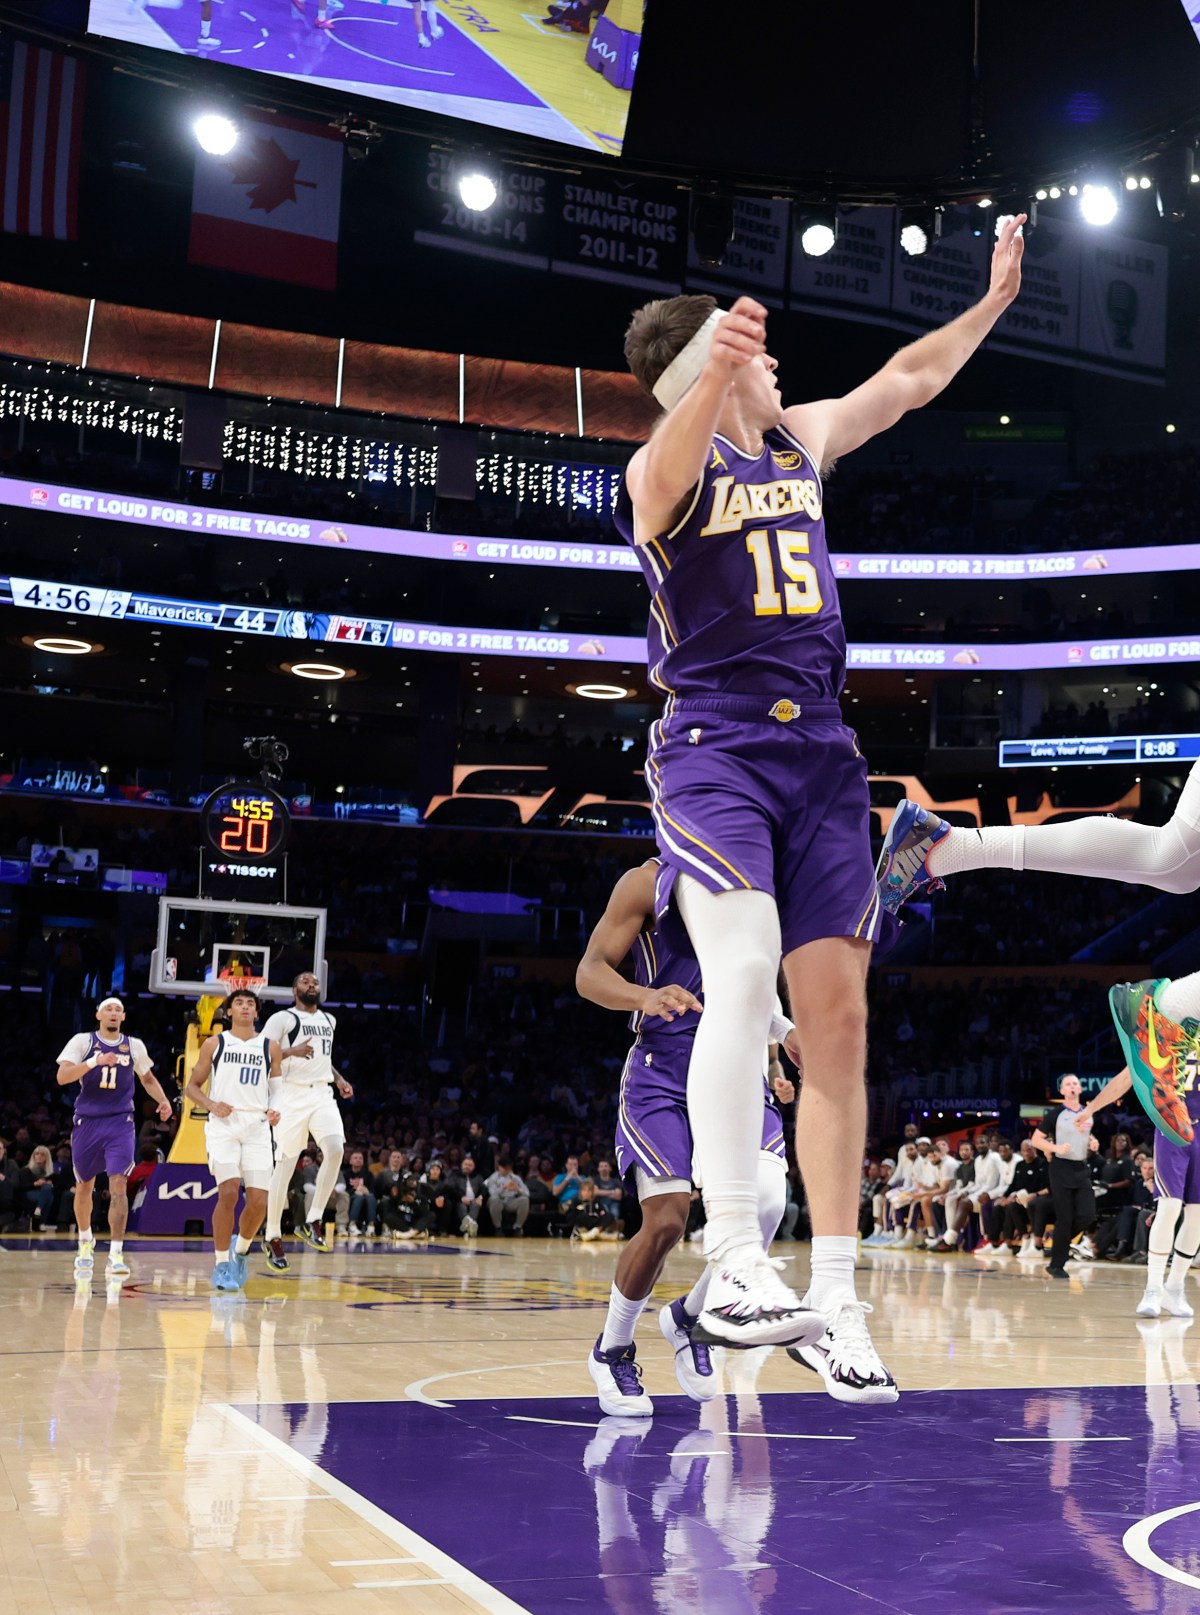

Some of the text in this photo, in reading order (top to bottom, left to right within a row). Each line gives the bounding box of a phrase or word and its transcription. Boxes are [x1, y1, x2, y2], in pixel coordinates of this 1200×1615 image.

[510, 173, 546, 193] CUP
[564, 184, 678, 222] STANLEY CUP
[562, 204, 677, 244] CHAMPIONS
[578, 233, 659, 271] 2011-12
[814, 271, 869, 293] 2011-12
[904, 269, 977, 297] CHAMPIONS
[1006, 311, 1060, 336] 1990-91
[58, 492, 95, 511] GET
[97, 498, 148, 519] LOUD
[151, 506, 188, 525] FOR
[191, 511, 203, 526] 2
[205, 513, 251, 532] FREE
[255, 519, 311, 538] TACOS
[700, 475, 823, 537] LAKERS
[477, 542, 509, 557] GET
[511, 544, 557, 561] LOUD
[560, 548, 593, 563] FOR
[596, 551, 607, 563] 2
[610, 550, 641, 566] FRE
[745, 529, 823, 616] 15
[858, 558, 891, 573] GET
[891, 559, 935, 574] LOUD
[937, 559, 970, 574] FOR
[972, 560, 982, 574] 2
[985, 559, 1025, 574] FREE
[1027, 557, 1075, 573] TACOS
[24, 584, 91, 611] 4:56
[111, 601, 122, 617] 2
[134, 601, 214, 623] Mavericks
[234, 610, 266, 632] 44
[345, 628, 357, 641] 4
[371, 630, 382, 643] 6
[418, 631, 453, 646] FOR
[457, 633, 467, 647] 2
[470, 635, 513, 650] FREE
[516, 637, 569, 653] TACOS
[851, 649, 945, 665] FREE TACOS
[1089, 643, 1120, 660] GET
[1122, 641, 1166, 658] LOUD
[1031, 745, 1108, 757] Love, Your Family
[1144, 742, 1176, 756] 8:08
[232, 798, 274, 820] 4:55
[221, 816, 268, 853] 20
[227, 864, 277, 878] TISSOT
[302, 1025, 332, 1037] DALLAS
[321, 1039, 332, 1056] 13
[223, 1052, 263, 1066] DALLAS
[99, 1066, 117, 1089] 11
[239, 1067, 260, 1086] 00
[931, 1098, 998, 1109] CHAMPIONS
